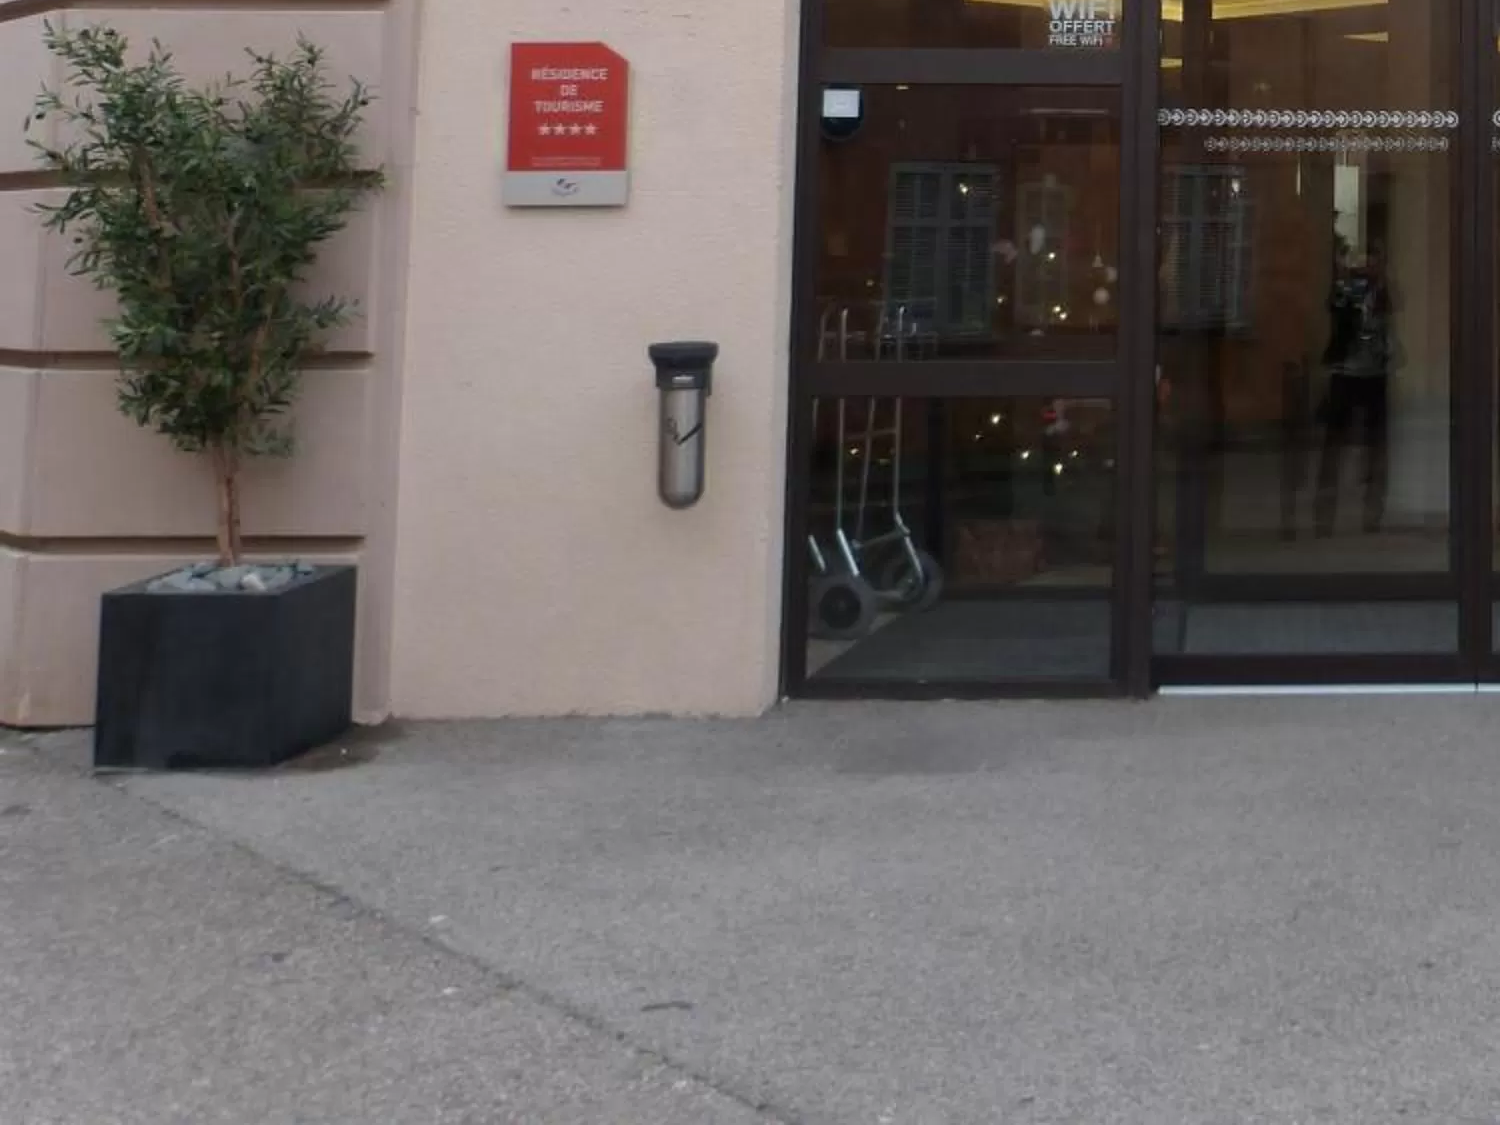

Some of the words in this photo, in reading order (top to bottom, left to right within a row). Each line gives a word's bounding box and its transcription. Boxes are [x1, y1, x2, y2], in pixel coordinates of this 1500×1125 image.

[1049, 20, 1116, 35] OFFERT
[531, 66, 609, 81] RÉSIDENCE
[559, 84, 578, 96] DE
[534, 100, 604, 113] TOURISME
